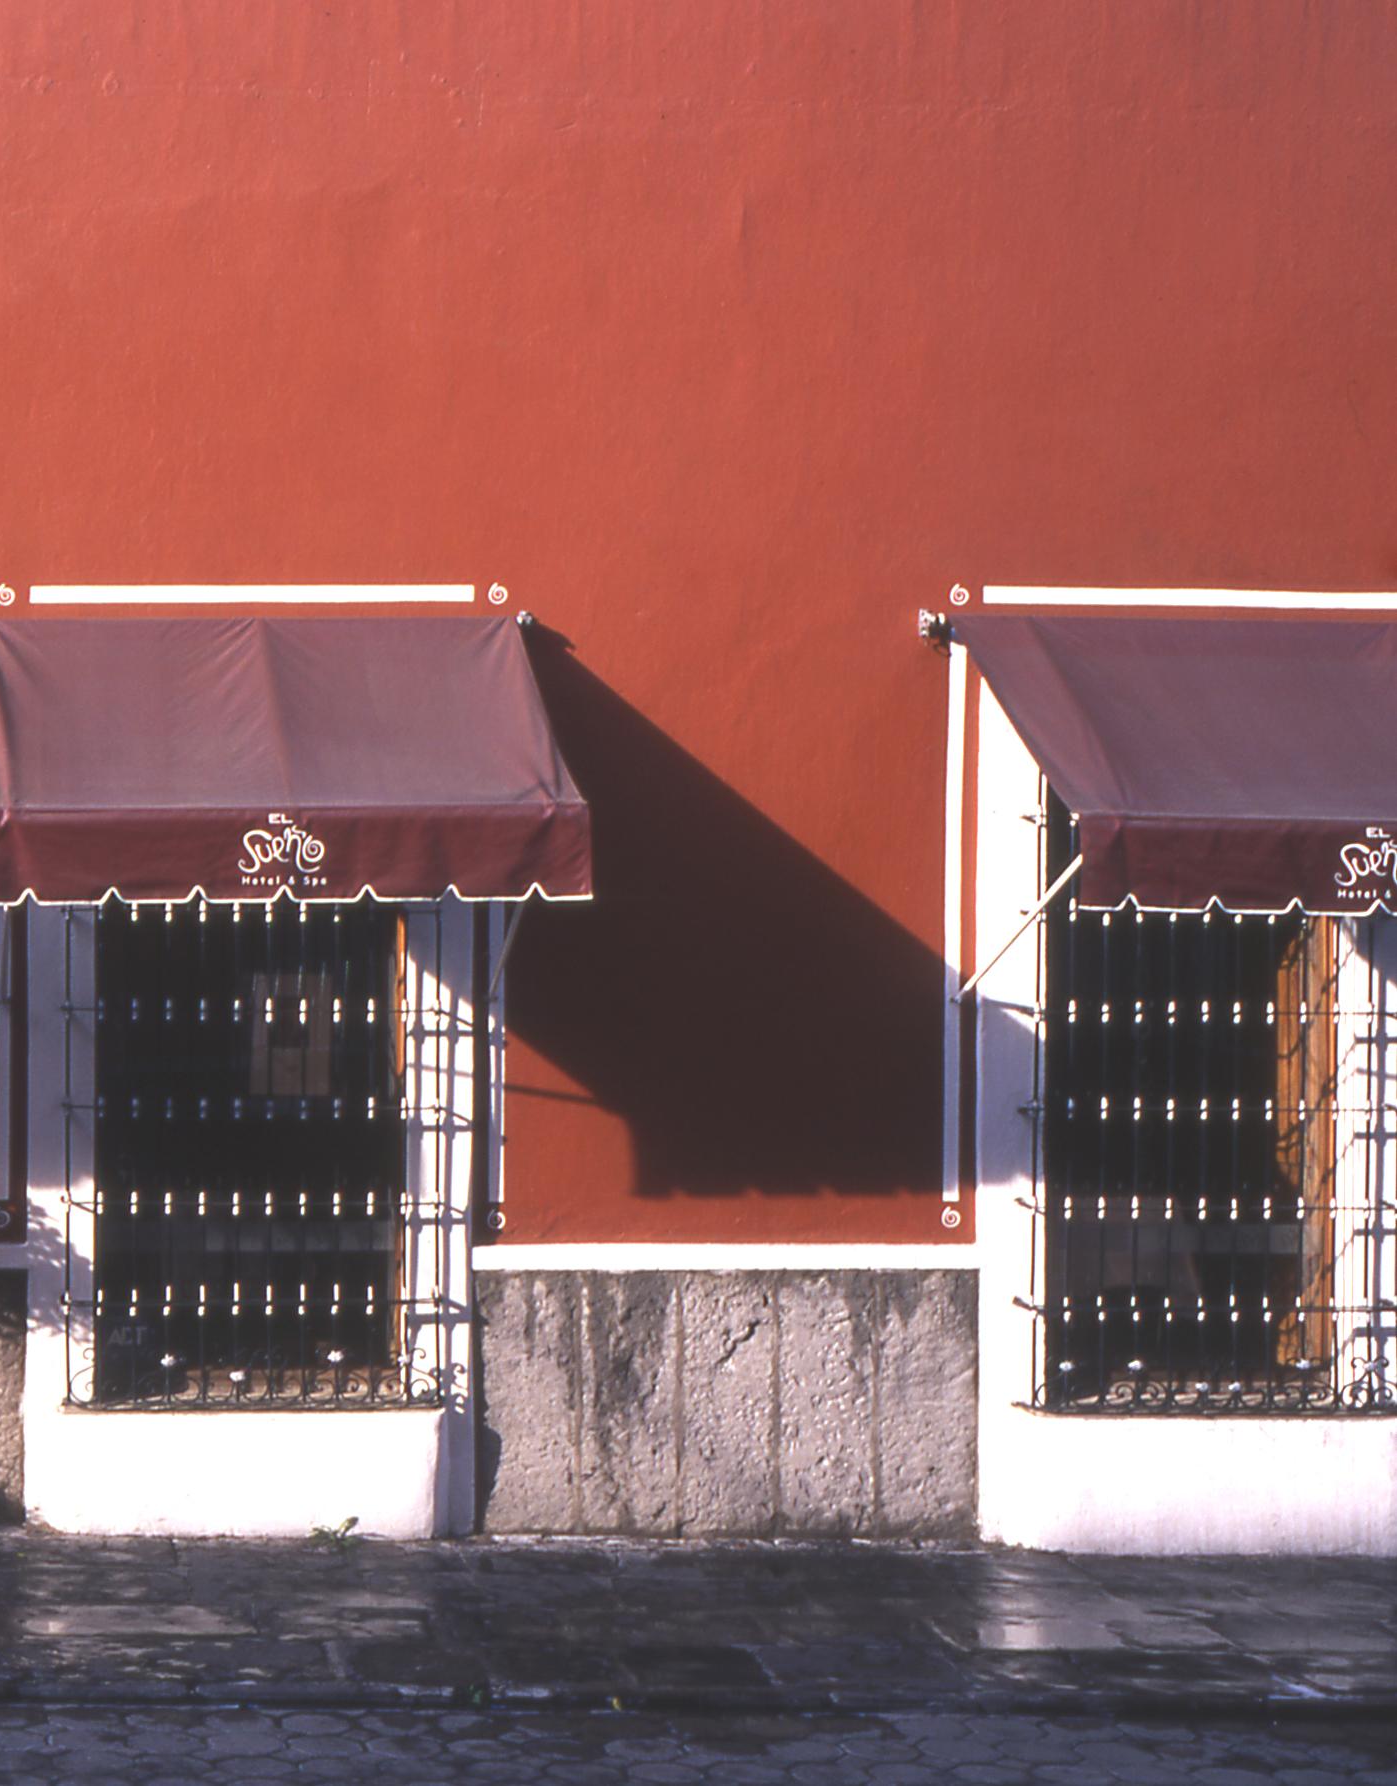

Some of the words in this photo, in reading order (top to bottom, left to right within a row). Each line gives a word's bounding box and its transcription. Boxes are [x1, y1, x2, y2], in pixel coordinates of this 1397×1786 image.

[268, 813, 294, 824] EL
[1366, 827, 1391, 838] EL
[238, 825, 325, 873] Sueño
[1334, 839, 1397, 887] Sueñ
[241, 875, 281, 887] Hotel
[302, 875, 328, 888] Spa
[1336, 888, 1377, 900] Hotel
